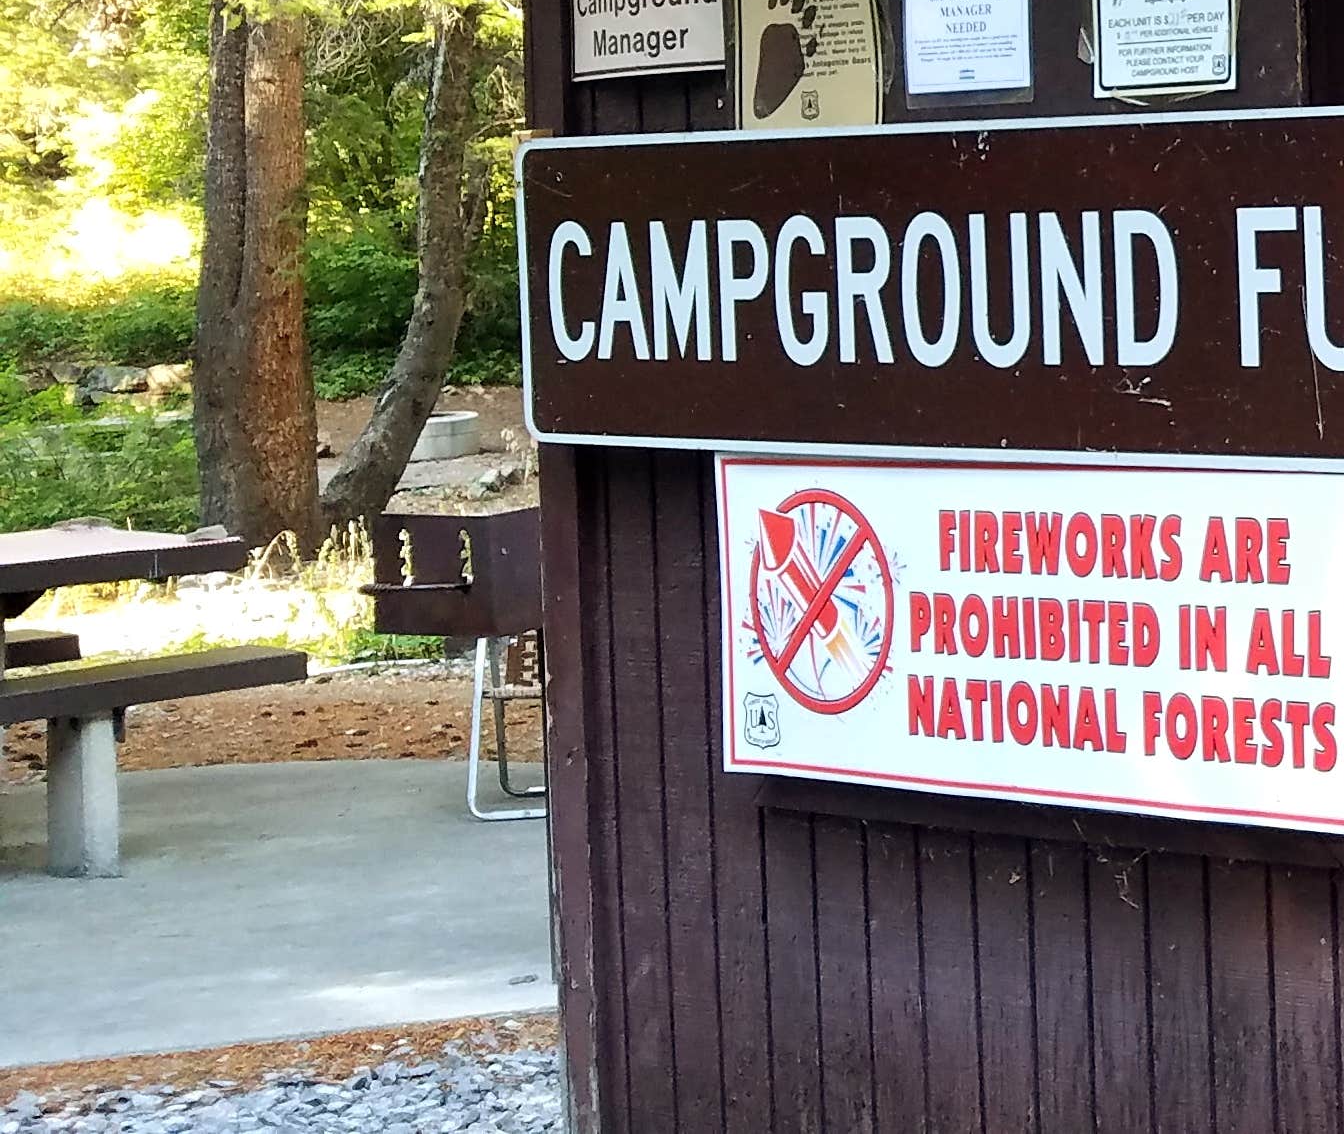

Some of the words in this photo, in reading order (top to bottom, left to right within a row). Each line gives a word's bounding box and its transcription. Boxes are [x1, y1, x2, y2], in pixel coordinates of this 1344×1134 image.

[940, 4, 992, 17] MANAGER
[1109, 19, 1130, 28] EACH
[1132, 17, 1151, 26] UNIT
[1154, 16, 1161, 25] IS
[1187, 13, 1204, 23] PER
[1207, 11, 1224, 21] DAY
[946, 22, 986, 34] NEEDED
[1154, 27, 1190, 36] ADDITIONAL
[1192, 25, 1219, 34] VEHICLE
[593, 27, 688, 58] Manager
[1119, 48, 1132, 56] FOR
[1134, 46, 1164, 55] FURTHER
[1166, 43, 1212, 52] INFORMATION
[1126, 58, 1151, 66] PLEASE
[1153, 56, 1184, 65] CONTACT
[1186, 55, 1204, 63] YOUR
[1132, 68, 1178, 77] CAMPGROUND
[1181, 66, 1199, 74] HOST
[547, 207, 1179, 368] CAMPGROUND
[939, 509, 1182, 582] FIREWORKS
[1200, 517, 1291, 585] ARE
[909, 592, 1161, 668] PROHIBITED
[1178, 604, 1228, 672] IN
[1247, 609, 1332, 678] ALL
[907, 675, 1126, 753] NATIONAL
[1143, 694, 1338, 772] FORESTS
